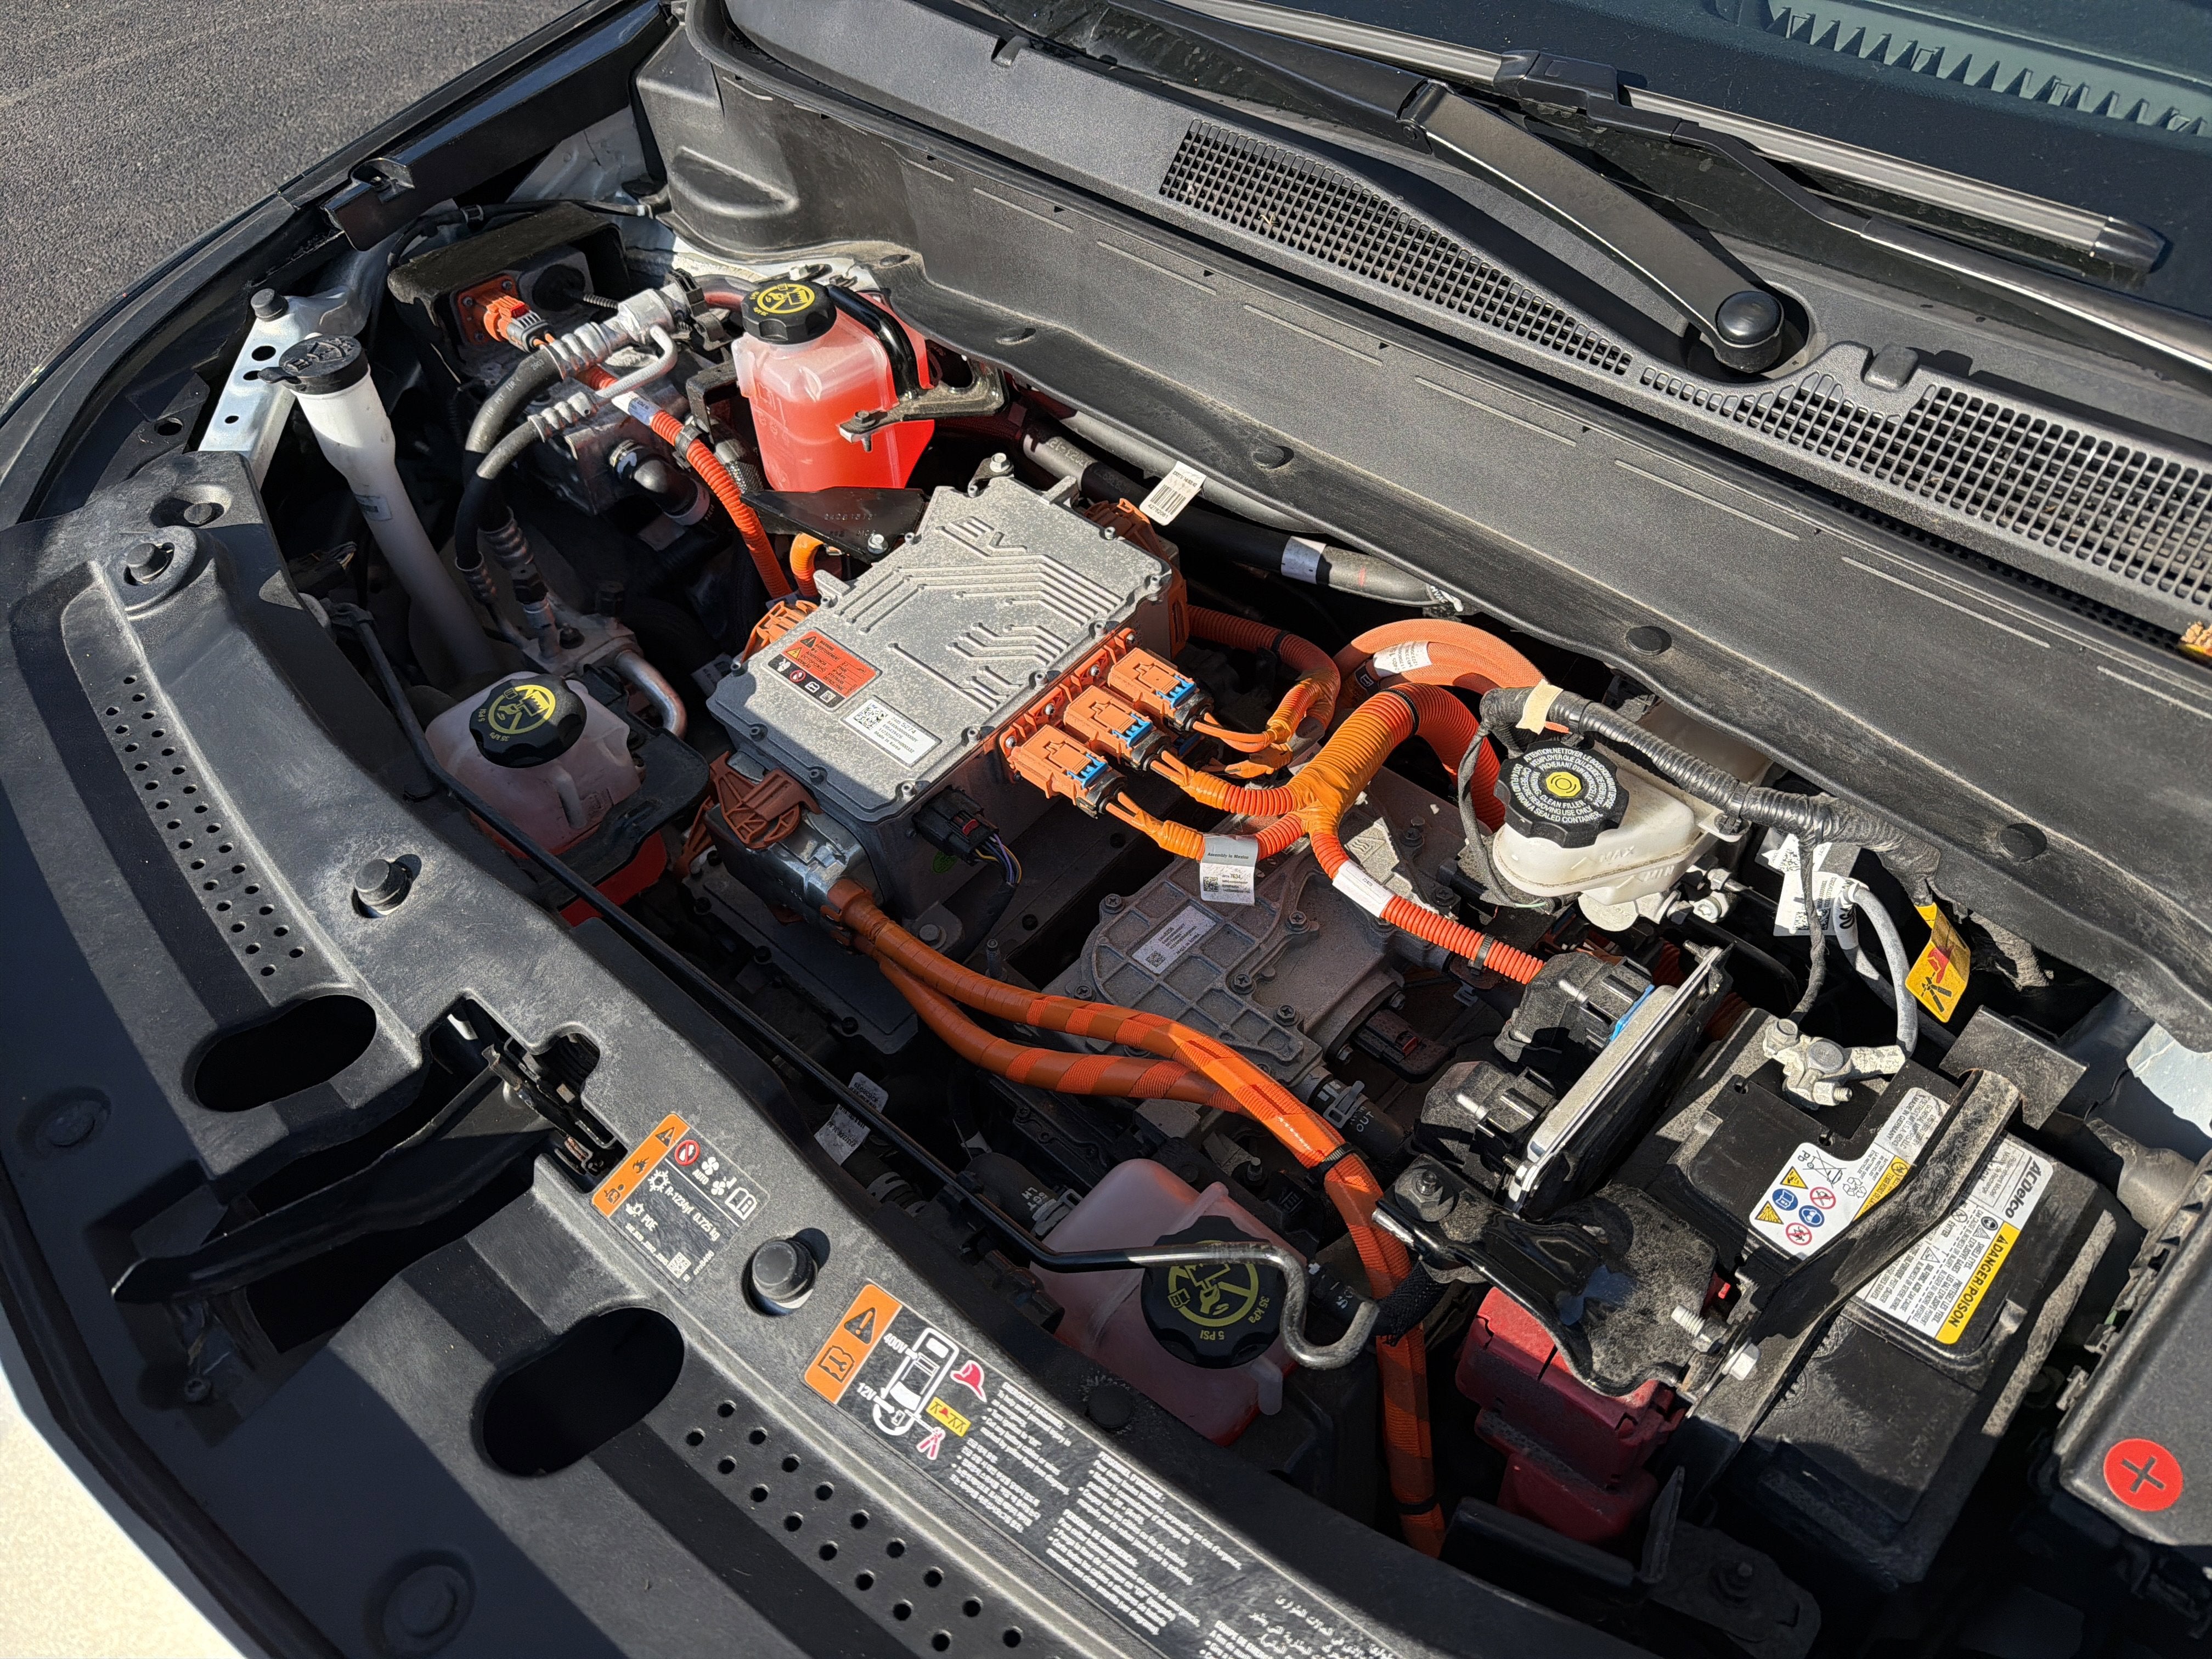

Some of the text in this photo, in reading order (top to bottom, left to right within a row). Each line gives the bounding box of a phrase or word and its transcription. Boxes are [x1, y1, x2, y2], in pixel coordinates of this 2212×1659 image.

[900, 722, 916, 735] 5274
[889, 741, 901, 751] Korea
[1552, 747, 1583, 758] NETTOYER
[1515, 792, 1531, 808] FROM
[1533, 806, 1560, 822] SEALED
[1561, 811, 1603, 823] CONTAINER
[1528, 795, 1561, 815] REMOVING
[1576, 805, 1593, 815] ONLY
[1539, 794, 1561, 808] CLEAN
[1562, 799, 1586, 809] FILLER
[1599, 845, 1635, 864] MAX
[1644, 864, 1675, 882] MIN
[1904, 1094, 1918, 1111] MADE
[1356, 1111, 1375, 1133] OUT
[1885, 1114, 1905, 1141] GERMANY
[1889, 1131, 1903, 1146] 48243
[1911, 1138, 1920, 1147] BY
[1797, 1149, 1810, 1162] Pb
[691, 1167, 710, 1186] AUTO
[1980, 1171, 1999, 1195] Rechange
[1988, 1182, 2001, 1198] Model
[2001, 1159, 2045, 1221] ACDelco
[640, 1213, 659, 1232] POE
[663, 1185, 722, 1242] R-1234yf 0.725 kg
[1949, 1236, 1976, 1273] EXPLOSIVE GASES
[1970, 1240, 1985, 1259] SHIELD
[1899, 1262, 1934, 1312] SULFURIC ACID CAN CAUSE
[1945, 1273, 1955, 1283] LES
[1946, 1242, 2004, 1328] DANGER/POISON
[1248, 1296, 1269, 1323] 35 kPa
[1938, 1300, 1949, 1311] LES
[882, 1331, 909, 1355] 400V
[1199, 1329, 1224, 1340] 5 PSI
[855, 1381, 878, 1402] 12V
[1026, 1412, 1051, 1433] personal
[1062, 1508, 1094, 1534] PERSONAL
[1090, 1528, 1102, 1540] DE
[1057, 1516, 1073, 1532] Para
[1106, 1554, 1139, 1581] personales
[1143, 1582, 1160, 1596] caso
[1156, 1592, 1168, 1602] de
[1045, 1547, 1075, 1571] marcados
[1071, 1567, 1085, 1578] con
[1081, 1574, 1098, 1589] cinta
[1095, 1584, 1120, 1605] amarilla
